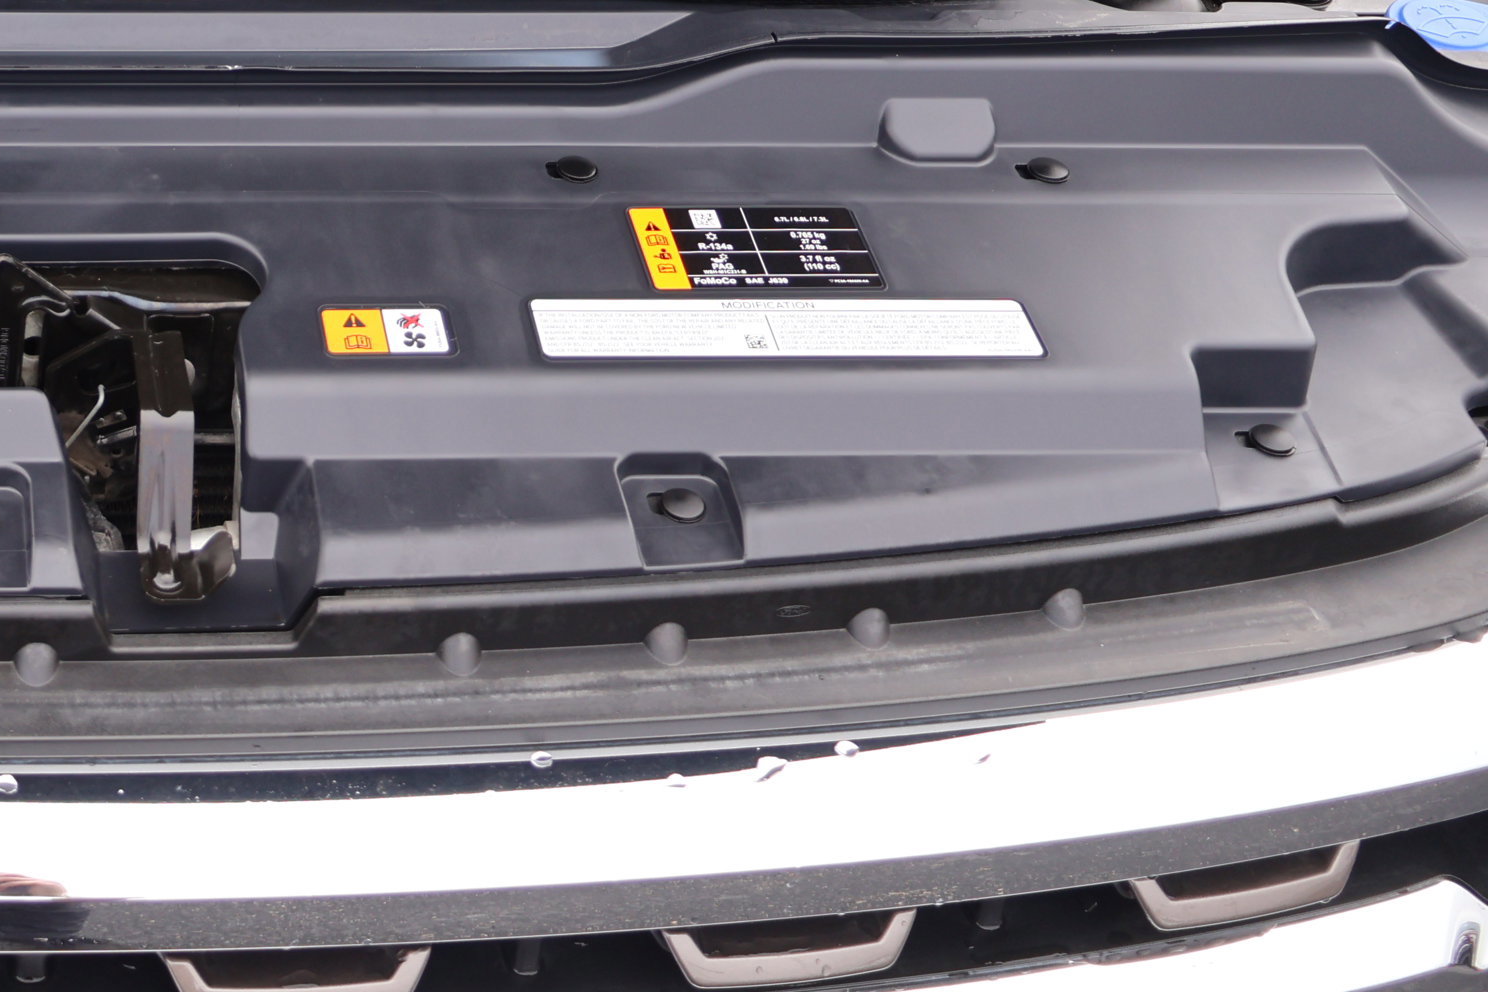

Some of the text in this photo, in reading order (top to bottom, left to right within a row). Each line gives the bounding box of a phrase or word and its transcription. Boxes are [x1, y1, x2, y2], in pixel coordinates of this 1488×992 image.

[814, 231, 827, 240] kg
[697, 243, 734, 251] R-134a
[799, 255, 813, 263] 3.7
[804, 262, 841, 272] (110 cc)
[693, 277, 738, 285] FoMoCo
[721, 301, 815, 310] MODIFICATION
